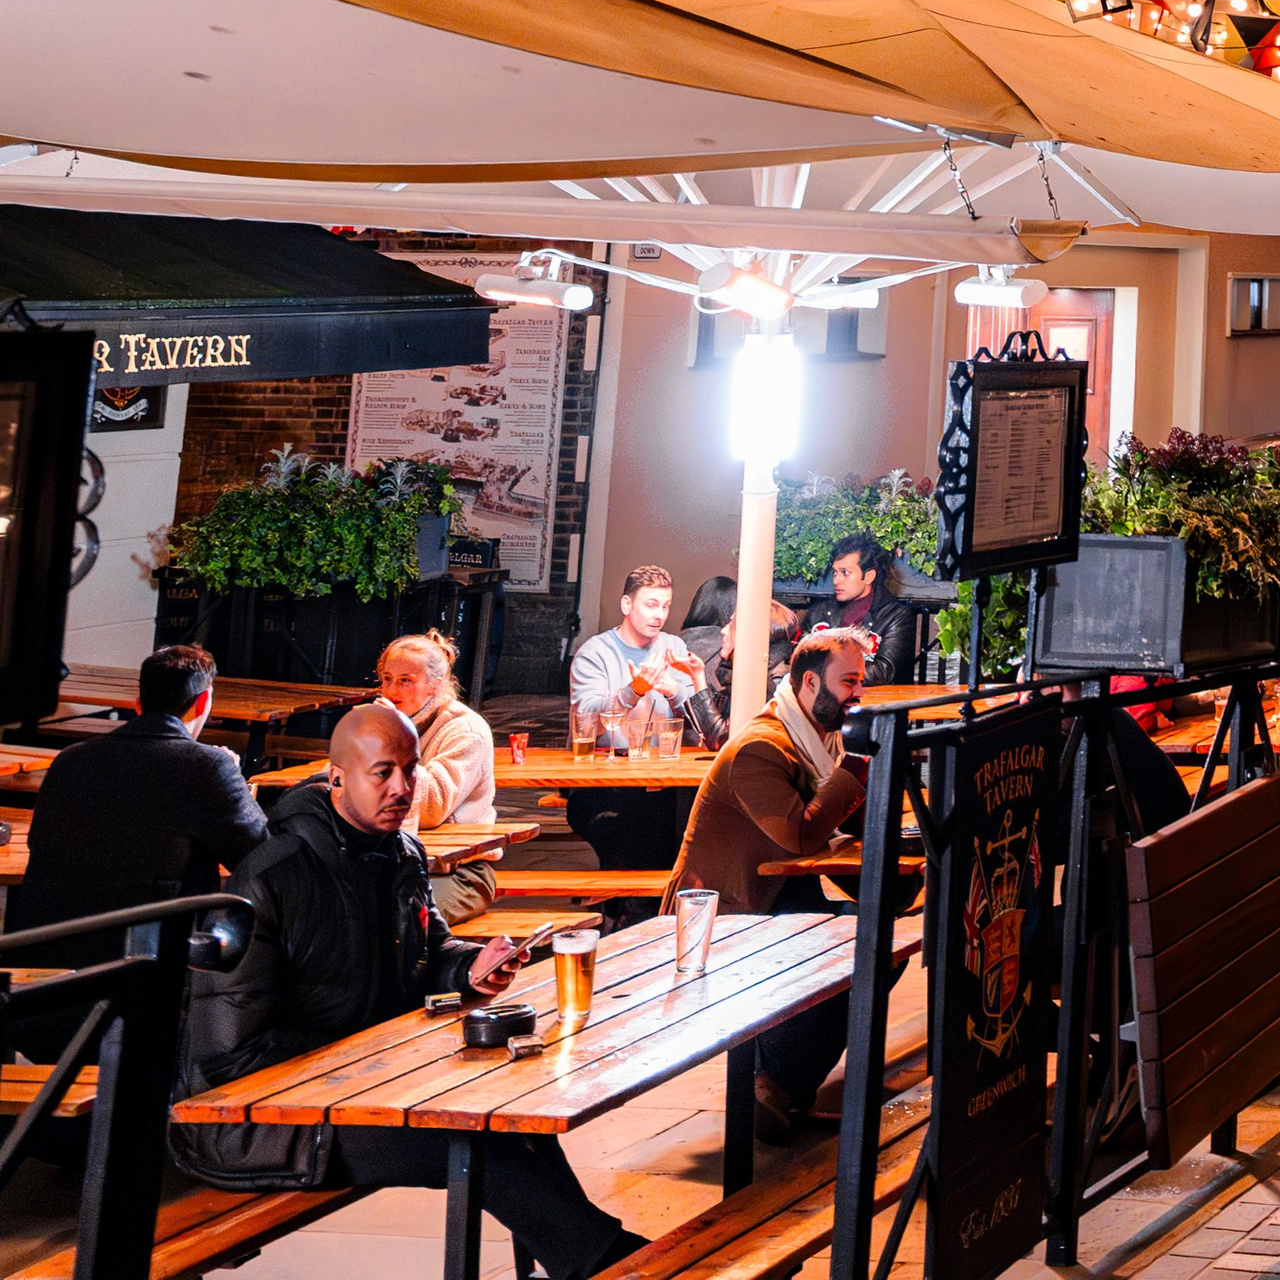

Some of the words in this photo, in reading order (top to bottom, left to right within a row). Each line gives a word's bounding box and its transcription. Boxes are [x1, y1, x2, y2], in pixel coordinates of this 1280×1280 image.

[119, 333, 251, 374] TAVERN
[974, 744, 1045, 796] TRAFALGAR
[984, 772, 1034, 816] TAVERN
